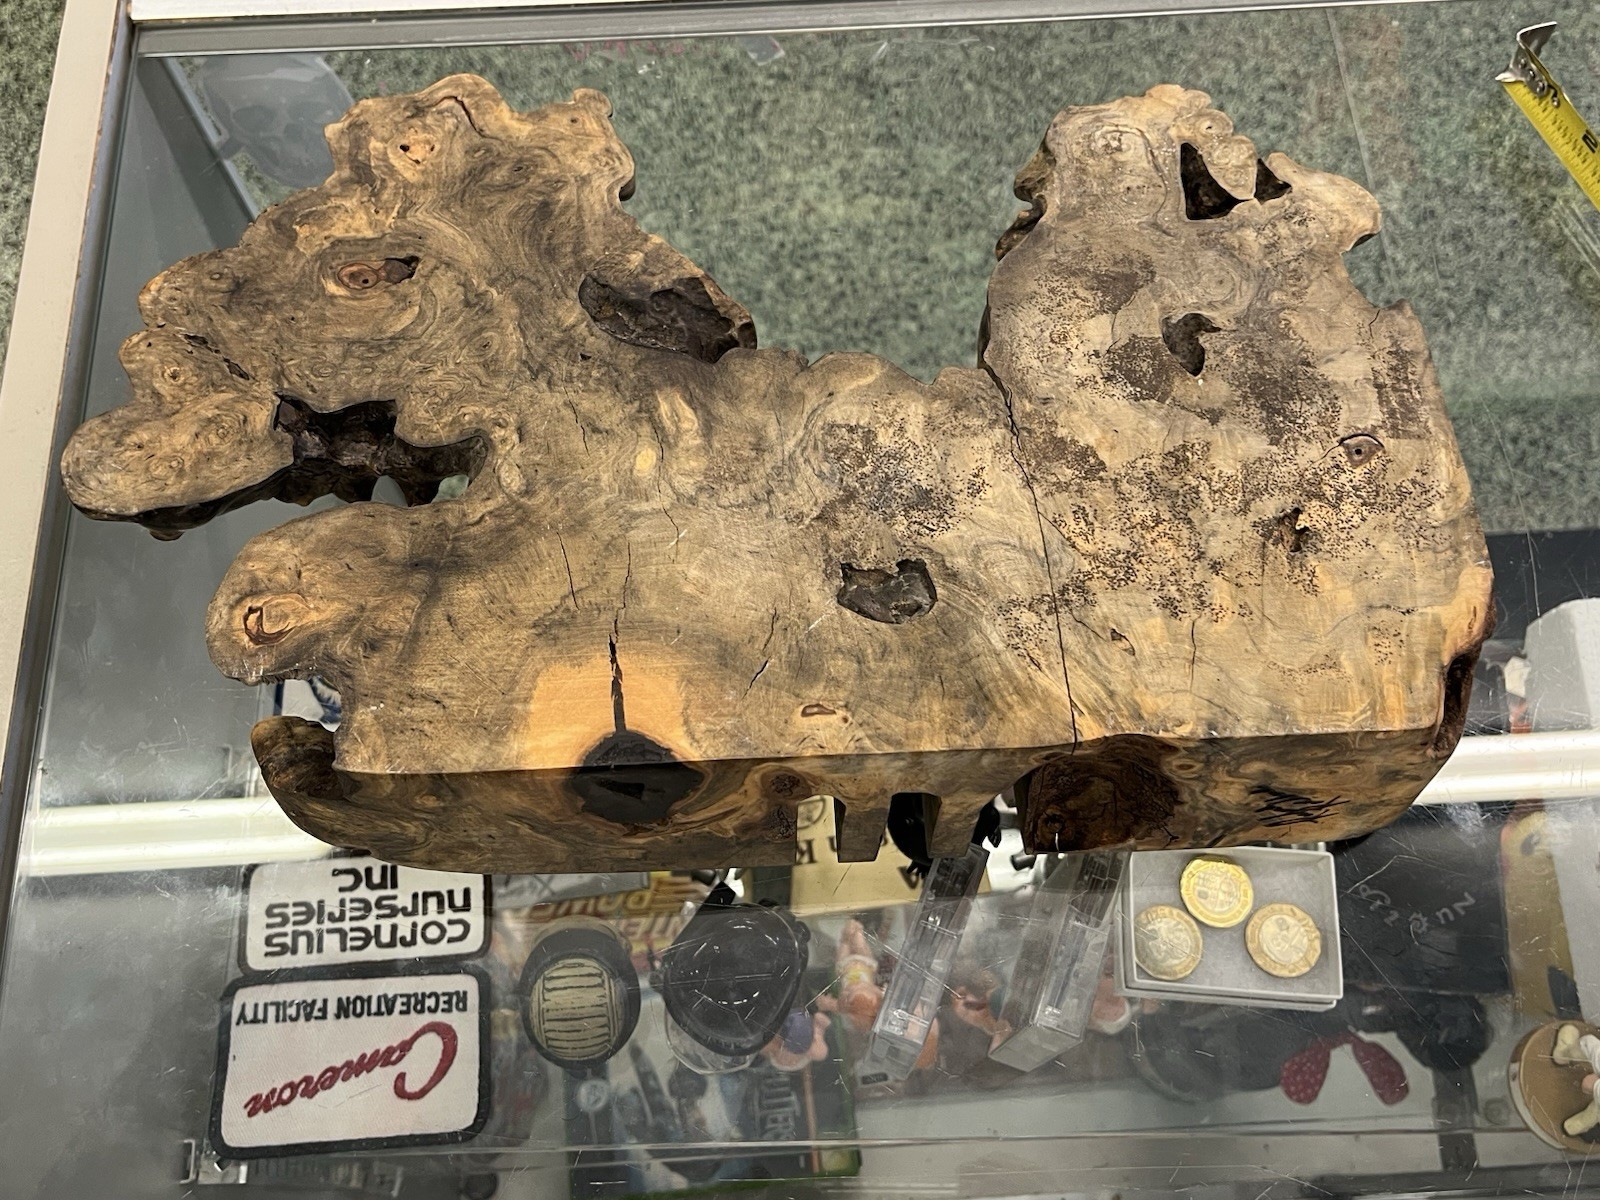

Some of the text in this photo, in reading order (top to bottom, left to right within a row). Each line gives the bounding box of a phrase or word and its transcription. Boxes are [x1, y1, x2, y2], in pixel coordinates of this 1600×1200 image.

[235, 990, 468, 1026] RECREATION FACILITY
[243, 1020, 458, 1118] Cameron
